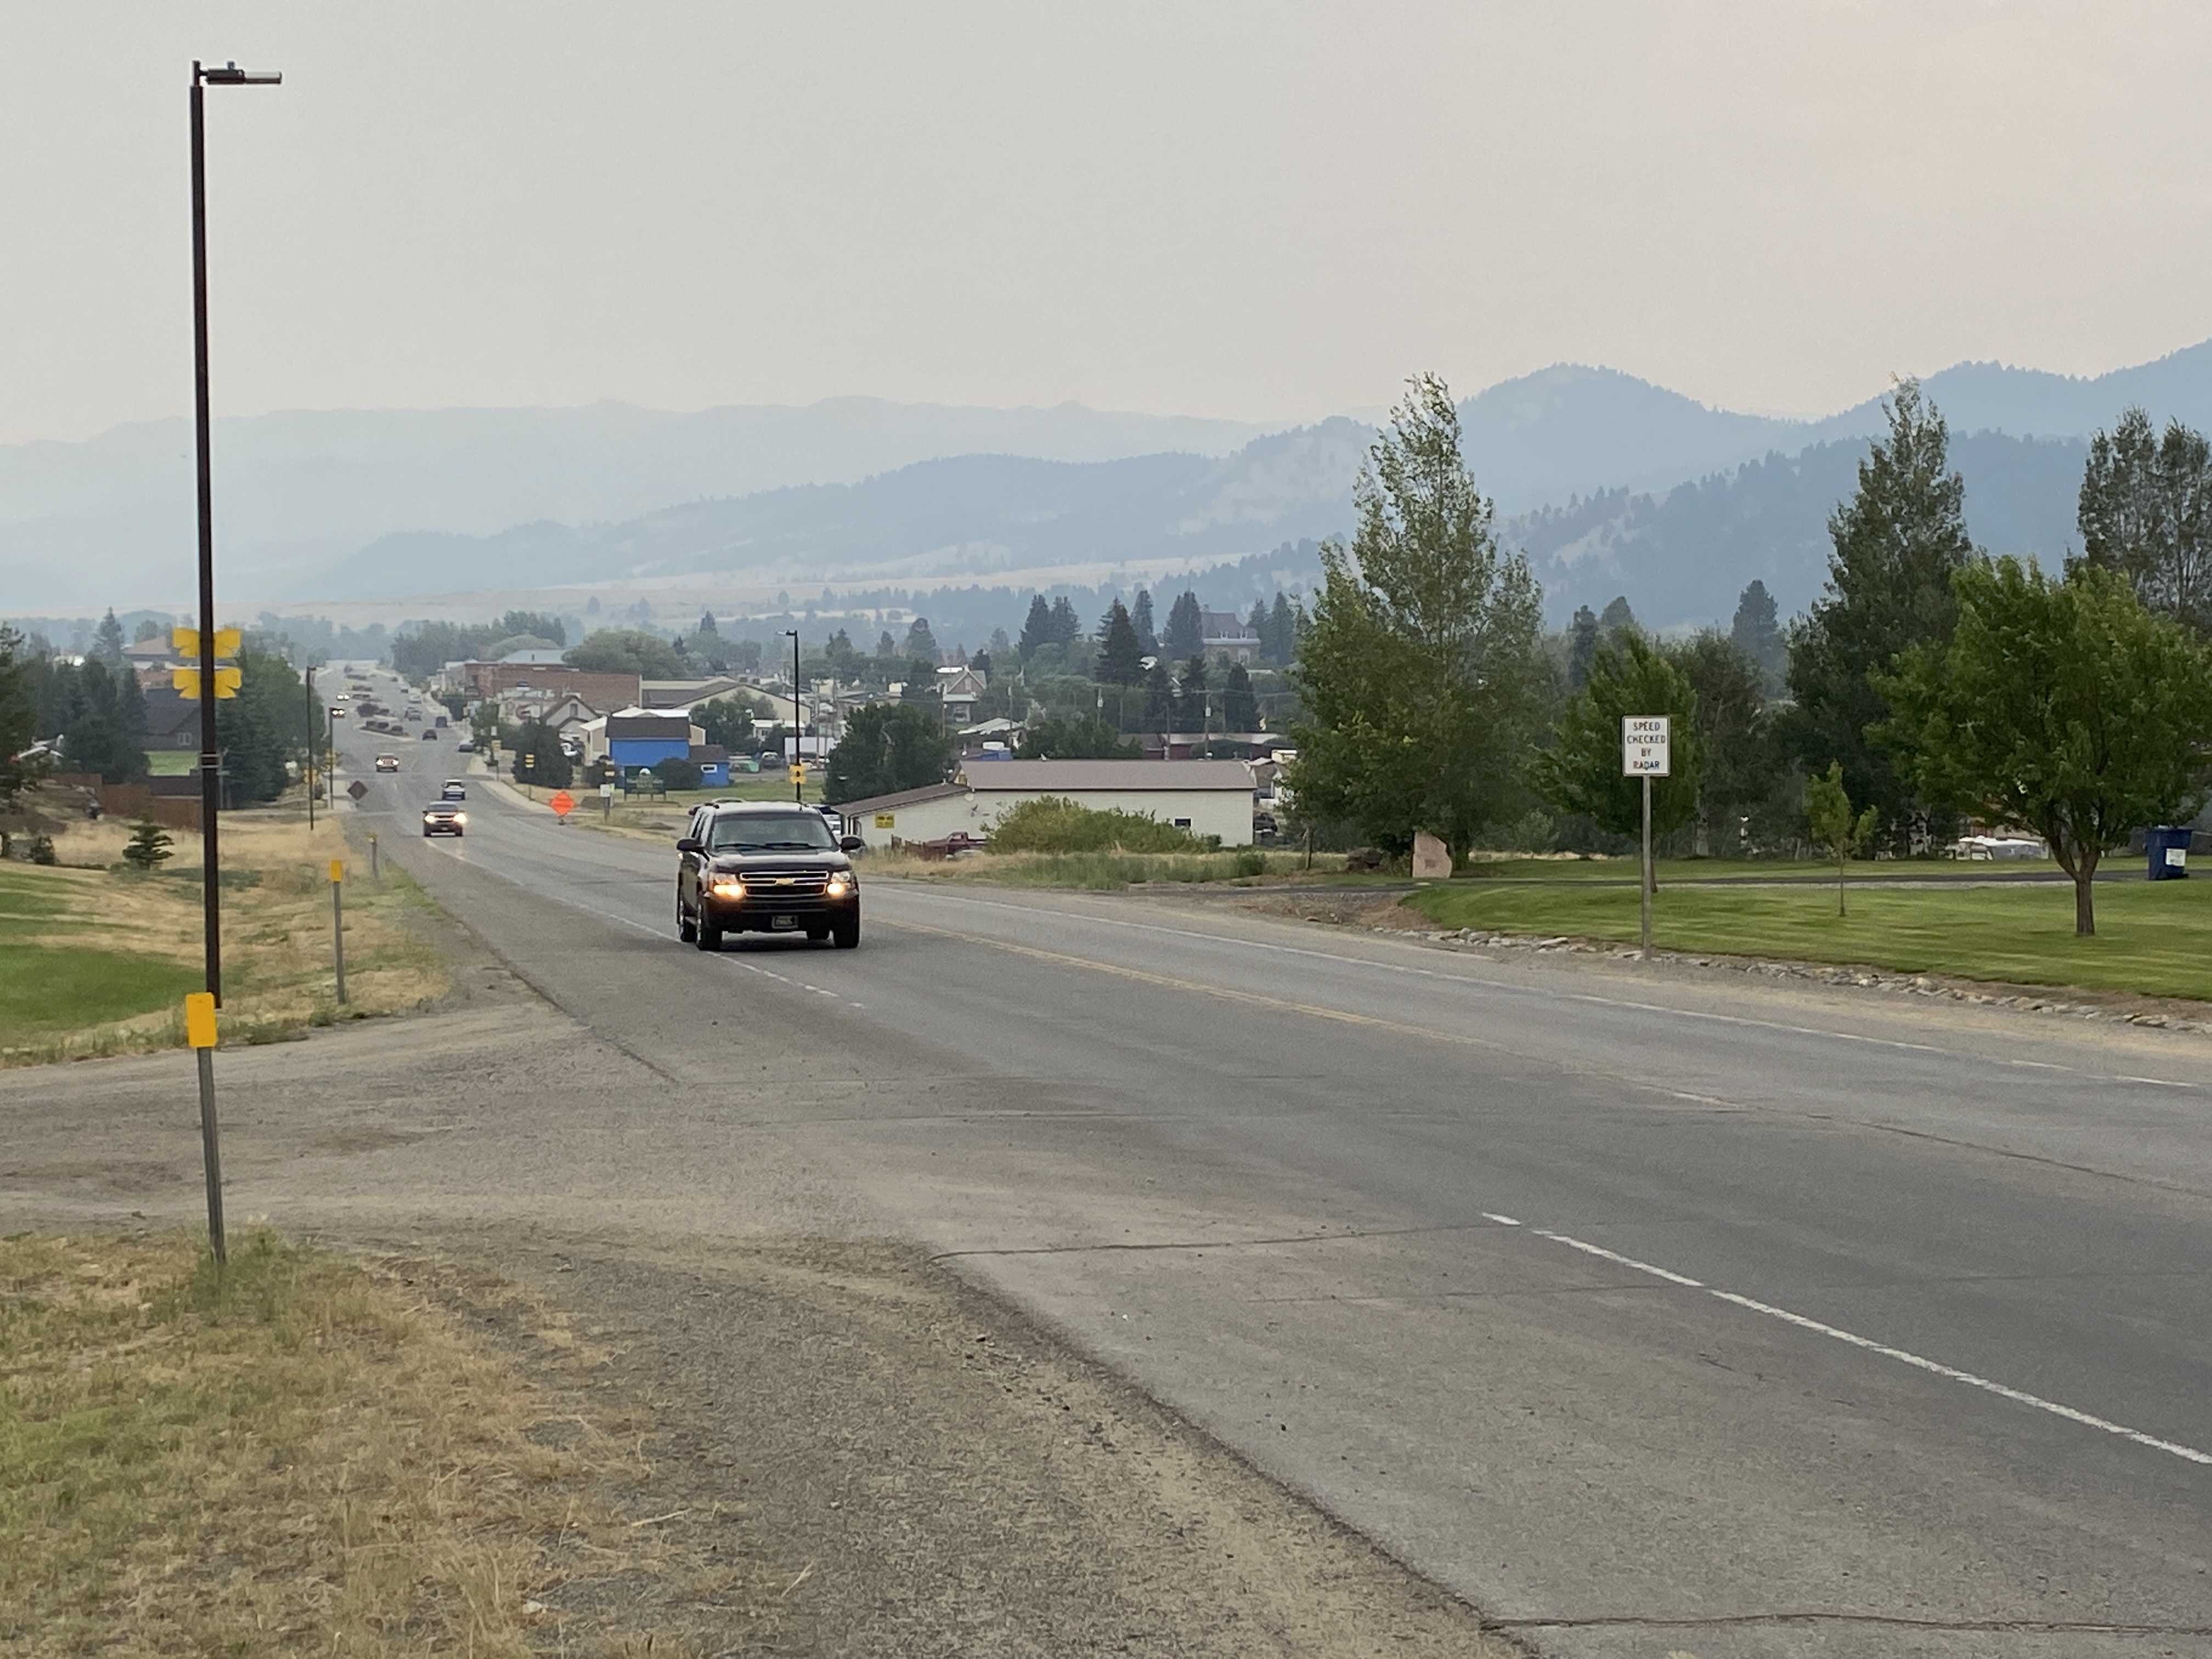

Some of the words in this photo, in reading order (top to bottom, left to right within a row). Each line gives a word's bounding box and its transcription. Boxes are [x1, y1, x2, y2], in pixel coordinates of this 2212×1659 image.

[1633, 721, 1660, 731] SPEED
[1627, 735, 1666, 744] CHECKED
[1641, 748, 1651, 757] BY
[1633, 761, 1660, 769] RADAR
